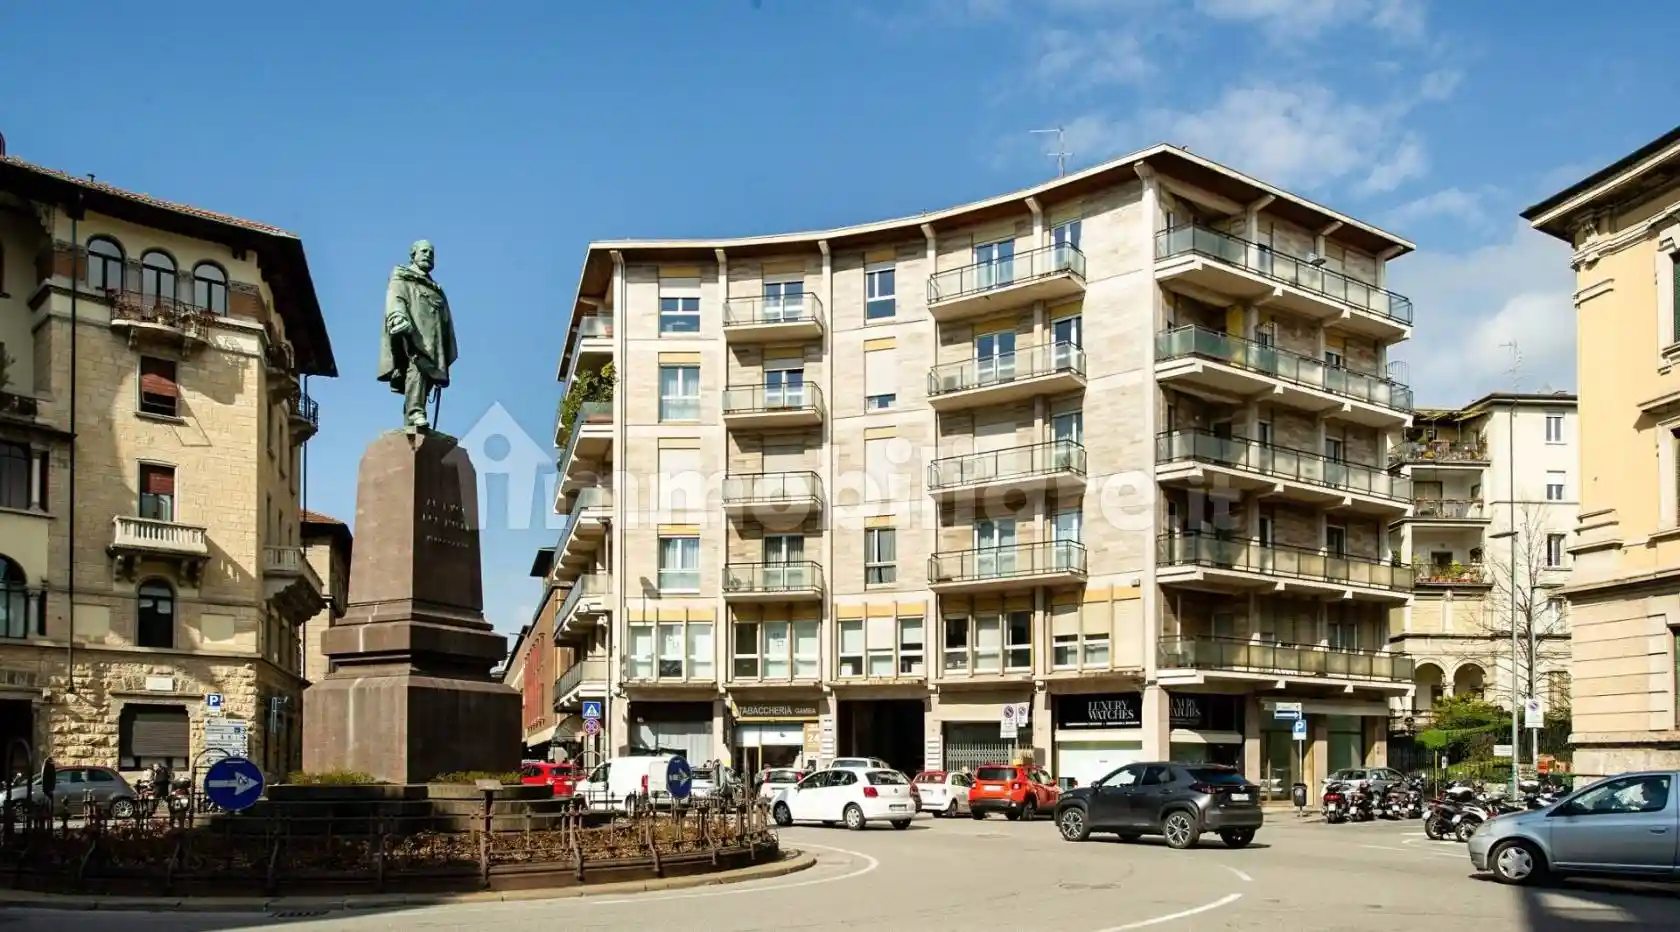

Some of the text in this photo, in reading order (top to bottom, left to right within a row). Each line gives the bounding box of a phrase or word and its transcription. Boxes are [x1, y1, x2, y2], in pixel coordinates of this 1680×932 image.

[209, 695, 219, 705] P
[1088, 700, 1129, 710] LUXURY
[739, 705, 792, 715] TABACCHERIA
[1088, 709, 1135, 720] WATCHES
[1295, 721, 1304, 732] P
